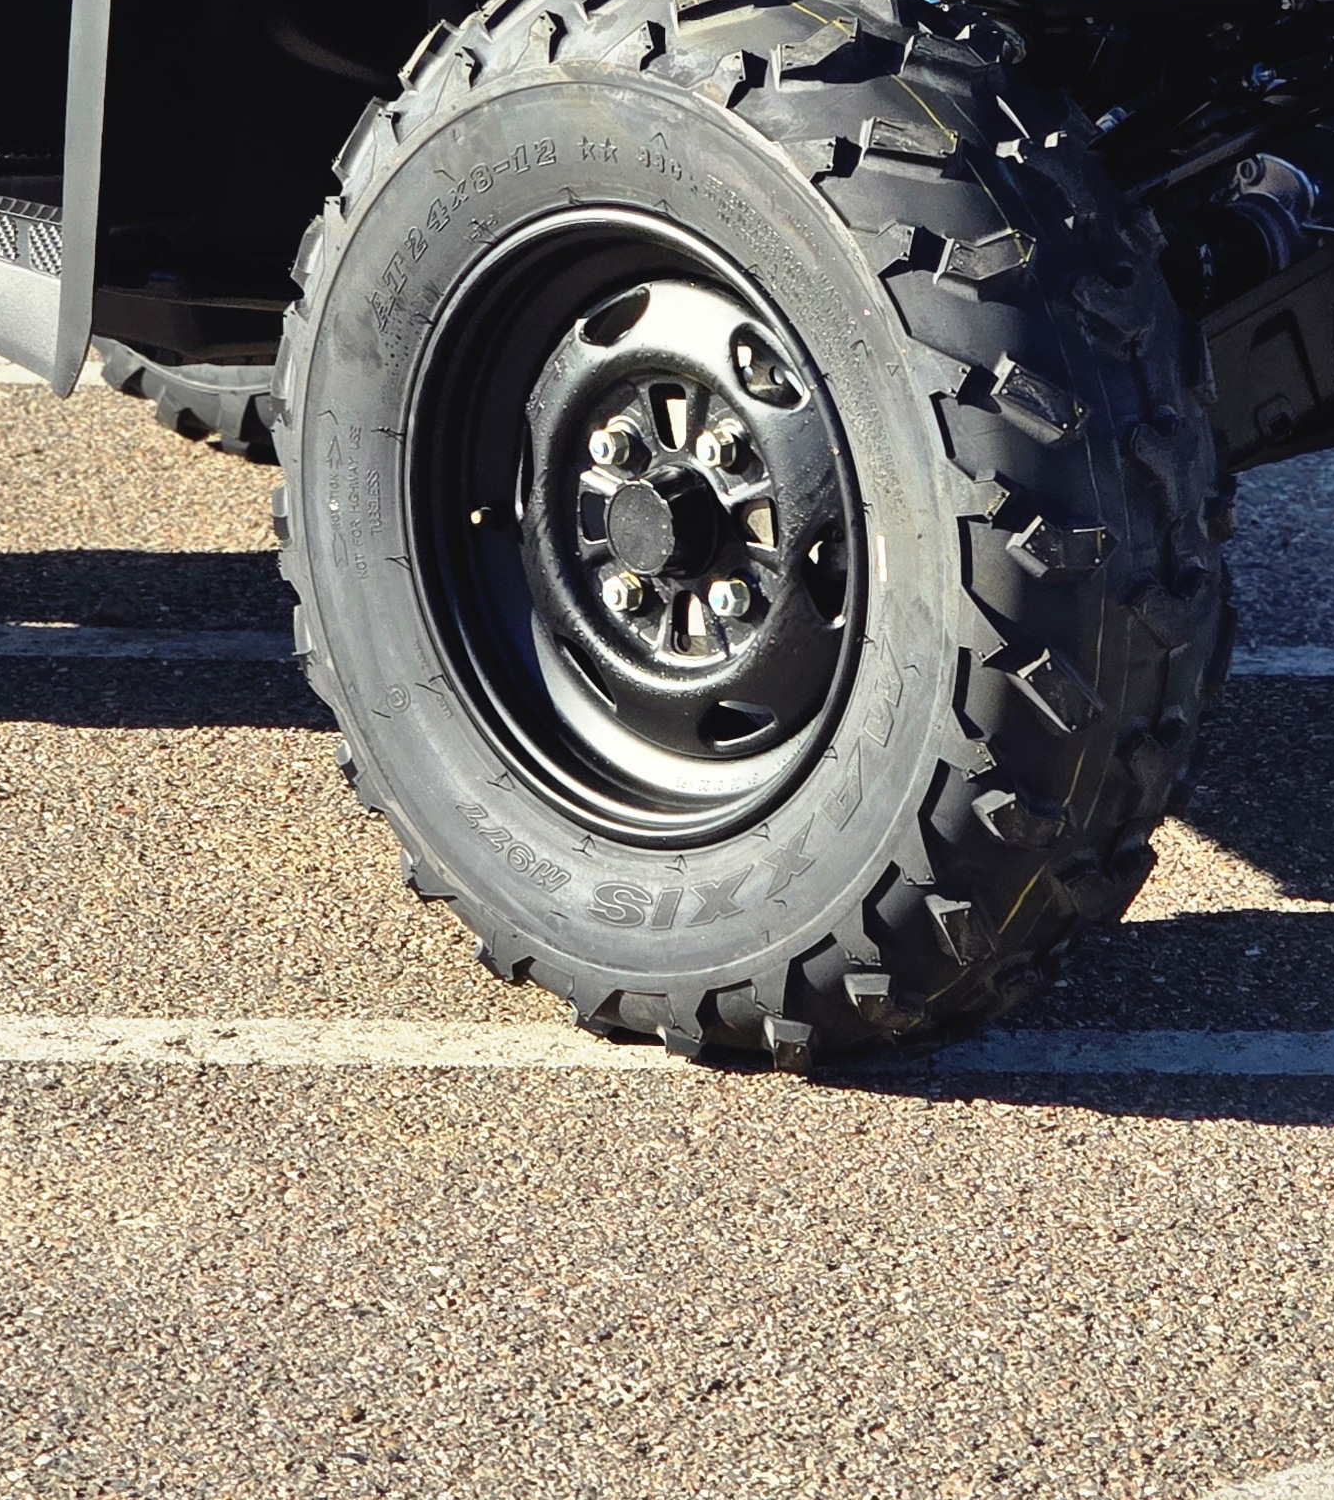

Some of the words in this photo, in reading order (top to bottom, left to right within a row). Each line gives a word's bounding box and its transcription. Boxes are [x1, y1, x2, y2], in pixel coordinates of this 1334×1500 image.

[349, 422, 362, 452] USE
[351, 518, 365, 547] FOR
[355, 551, 370, 580] NOT
[585, 636, 904, 933] MAXXIS
[454, 802, 572, 894] M977
